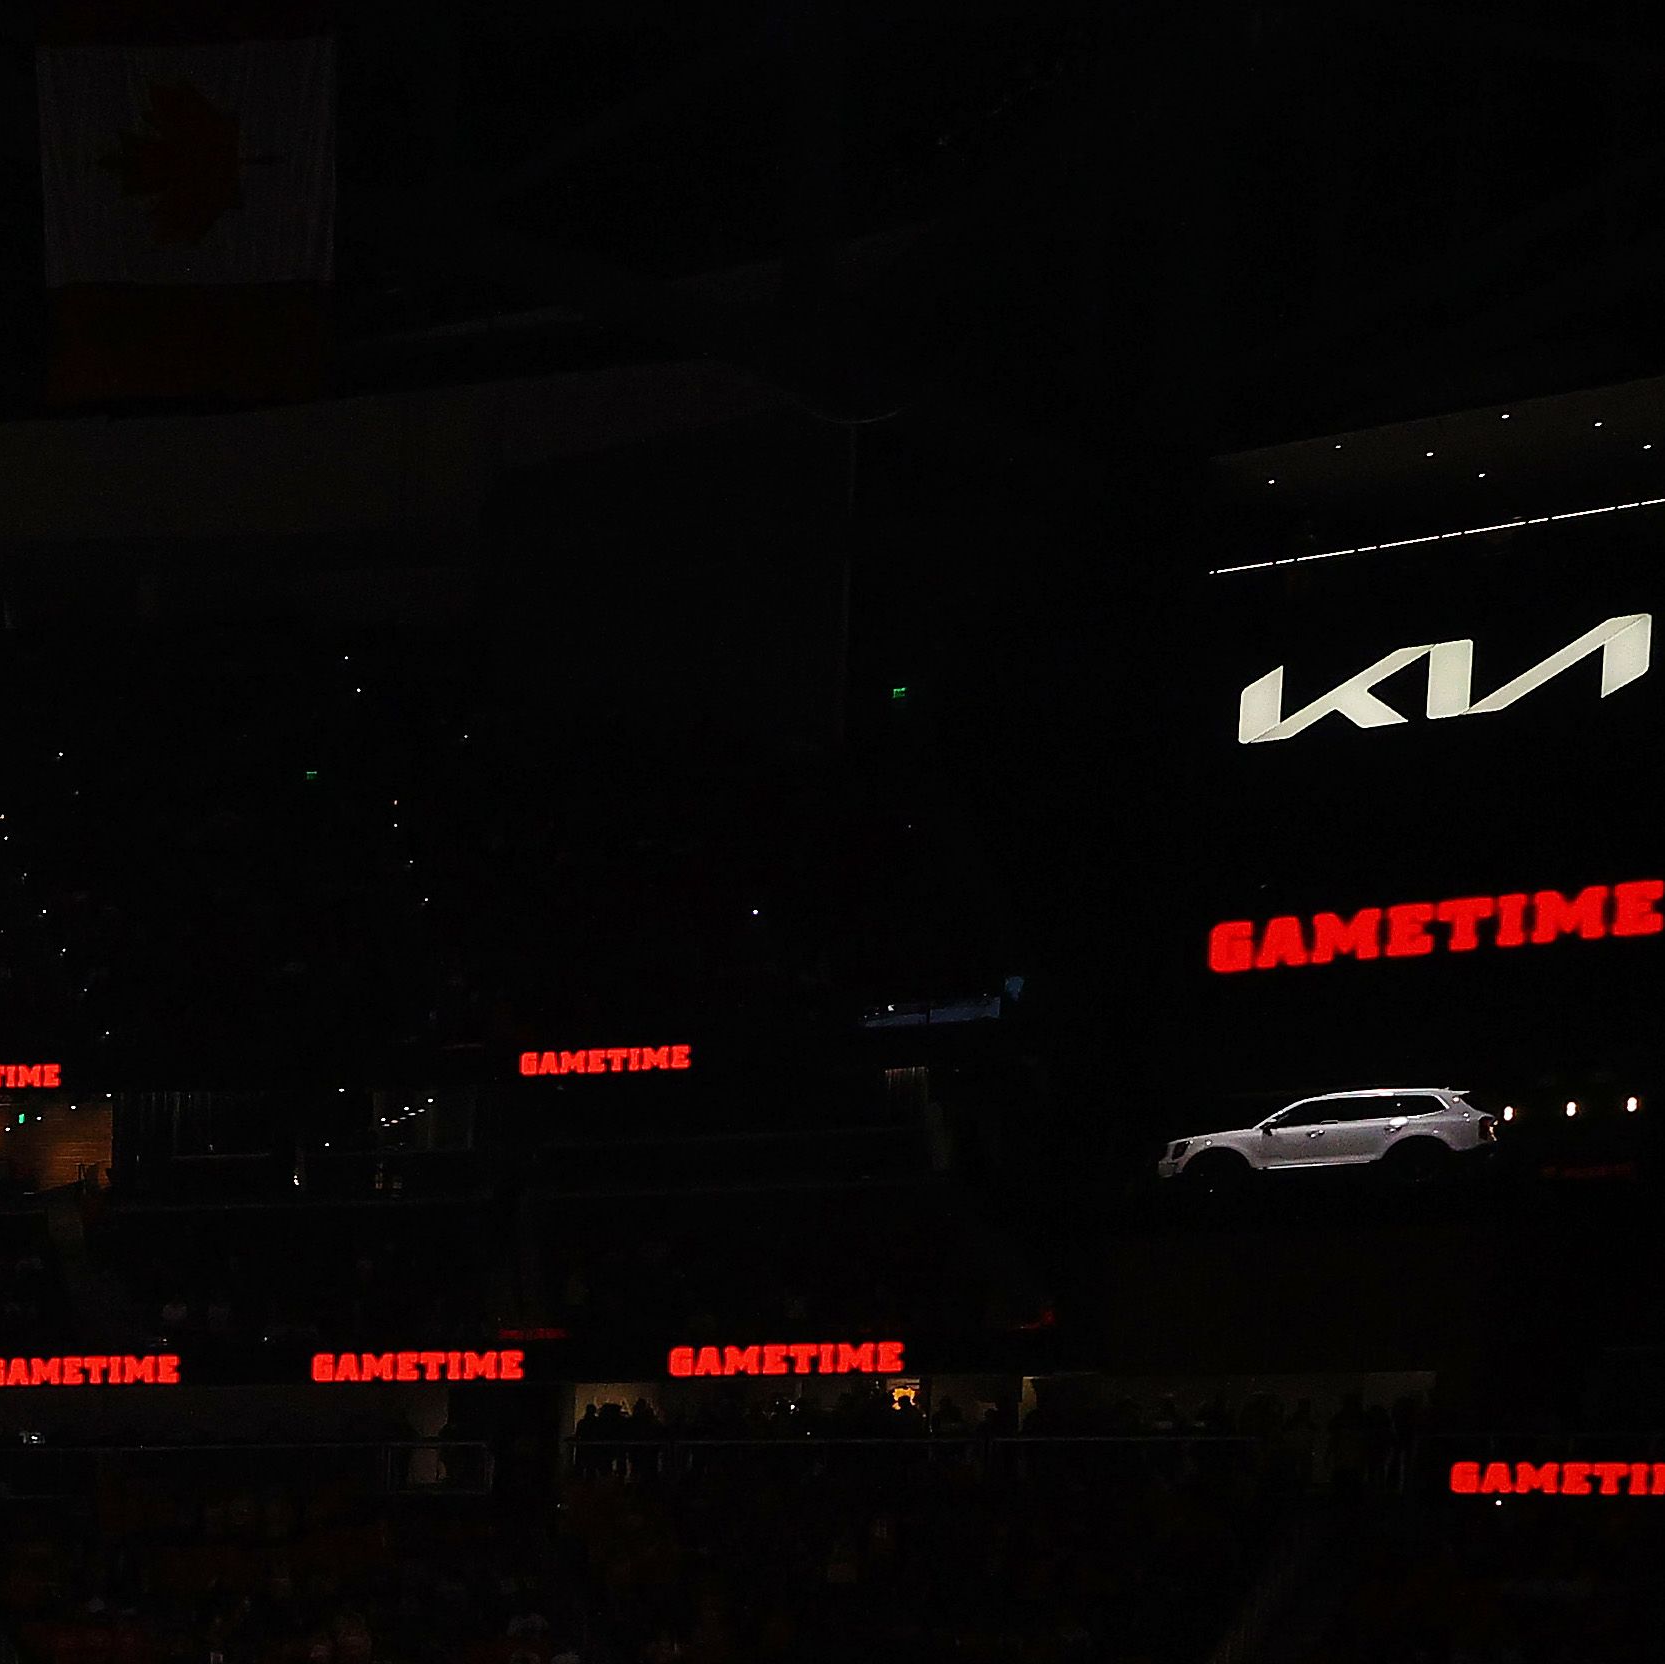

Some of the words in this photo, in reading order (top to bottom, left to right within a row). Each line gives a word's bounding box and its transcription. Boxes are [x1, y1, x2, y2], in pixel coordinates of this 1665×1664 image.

[1209, 880, 1664, 972] GAMETIME
[520, 1045, 691, 1076] GAMETIME
[312, 1350, 524, 1382] GAMETIME
[669, 1342, 904, 1377] GAMETIME
[1451, 1462, 1665, 1495] GAMETI
